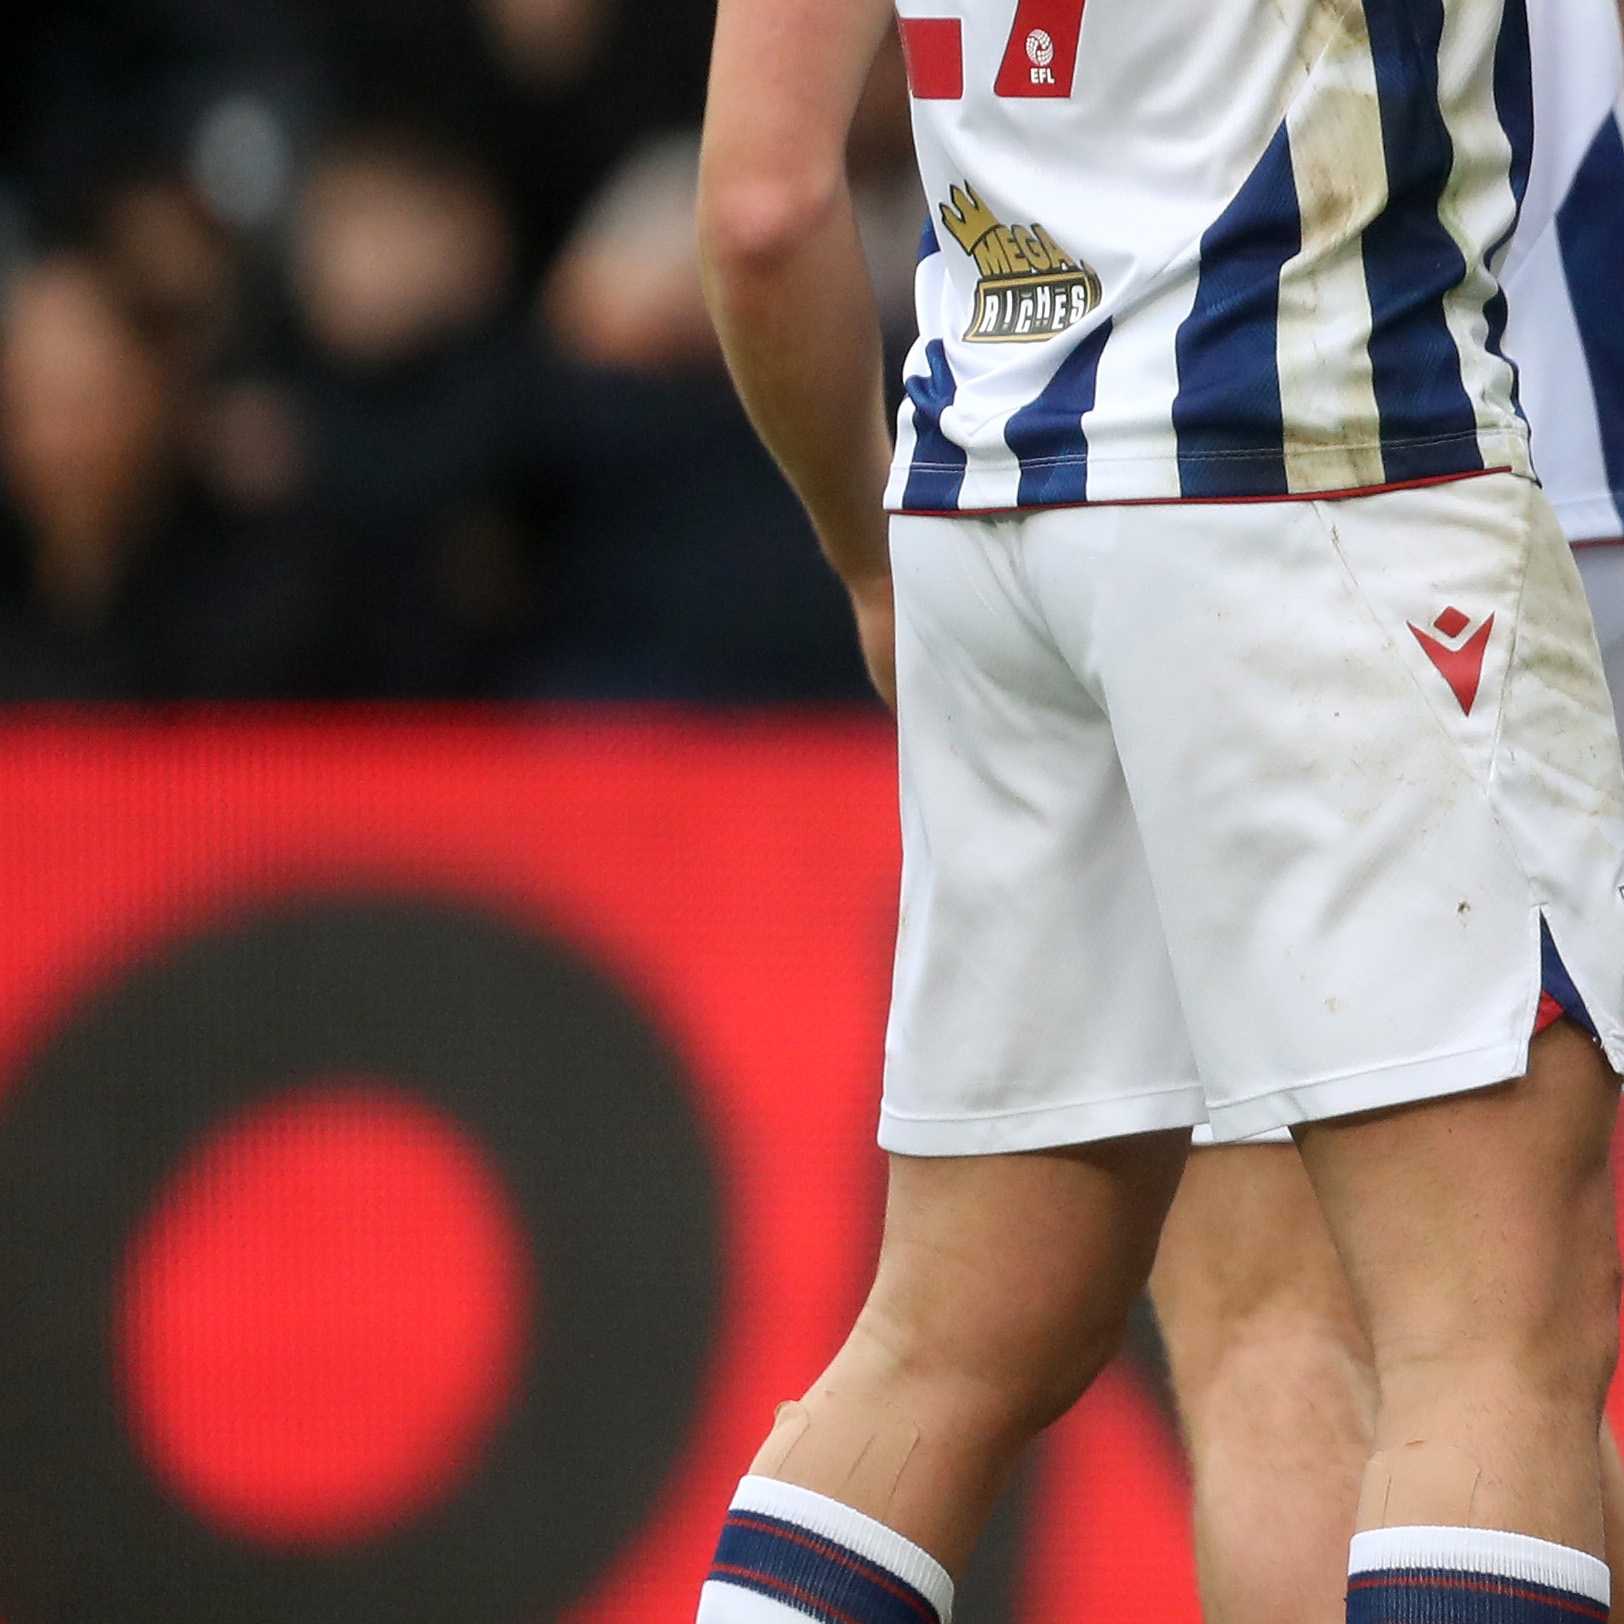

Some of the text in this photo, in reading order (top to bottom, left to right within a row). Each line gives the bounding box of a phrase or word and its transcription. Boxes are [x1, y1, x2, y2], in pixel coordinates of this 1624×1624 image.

[1030, 67, 1056, 84] EFL
[972, 222, 1080, 277] MEGA
[977, 284, 1085, 334] RICHES
